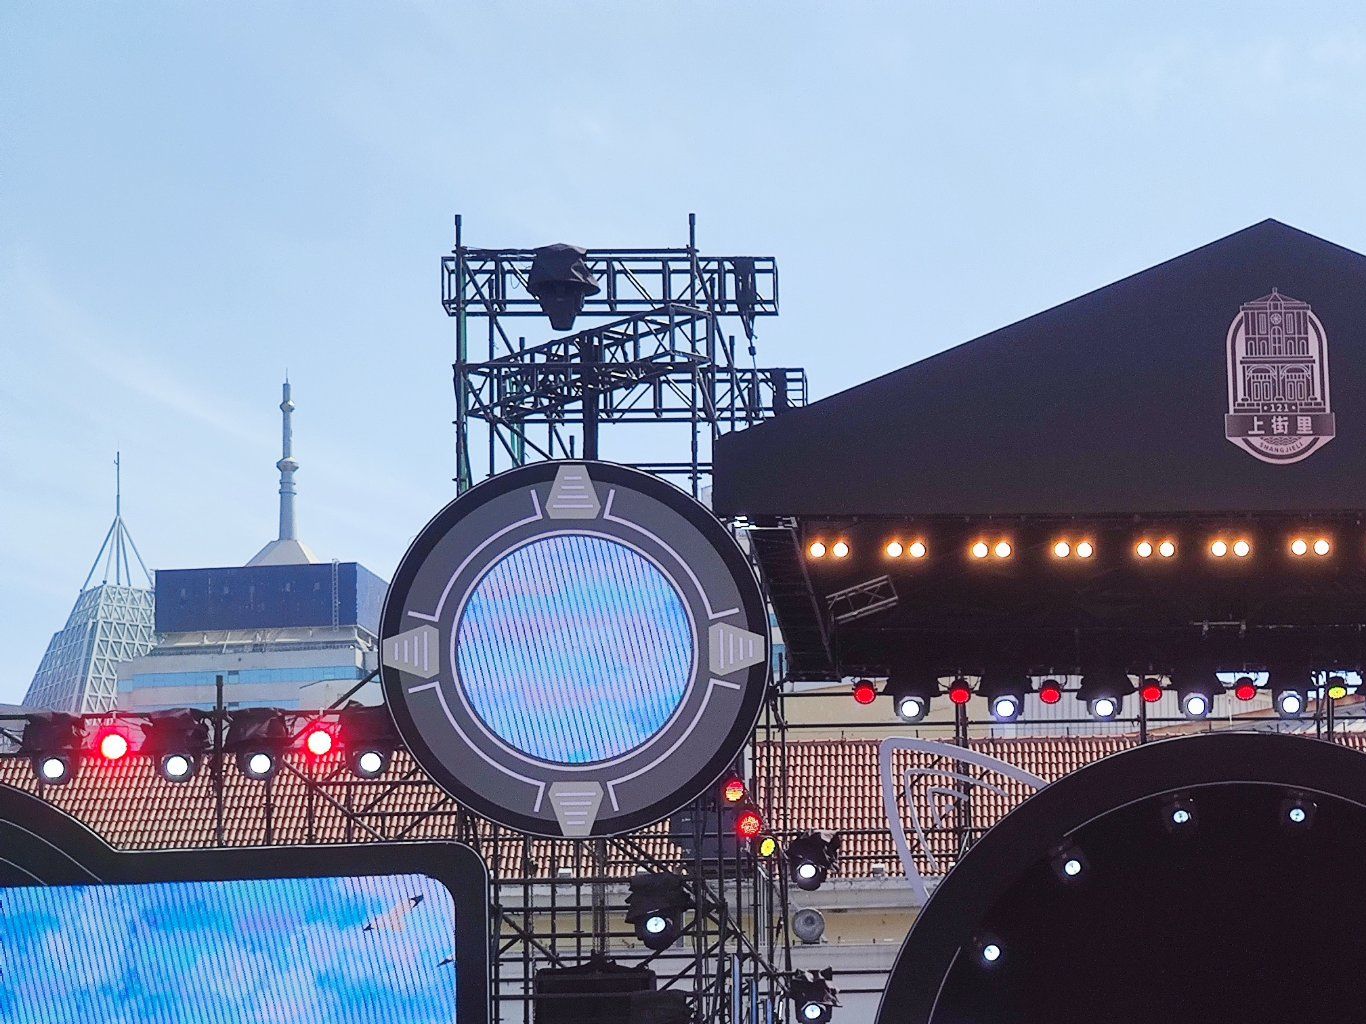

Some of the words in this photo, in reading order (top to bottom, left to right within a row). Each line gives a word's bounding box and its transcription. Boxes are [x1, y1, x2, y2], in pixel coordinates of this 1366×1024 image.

[1269, 403, 1290, 412] 121
[1247, 415, 1314, 435] 上街里
[1259, 440, 1304, 454] SHANGJIELI
